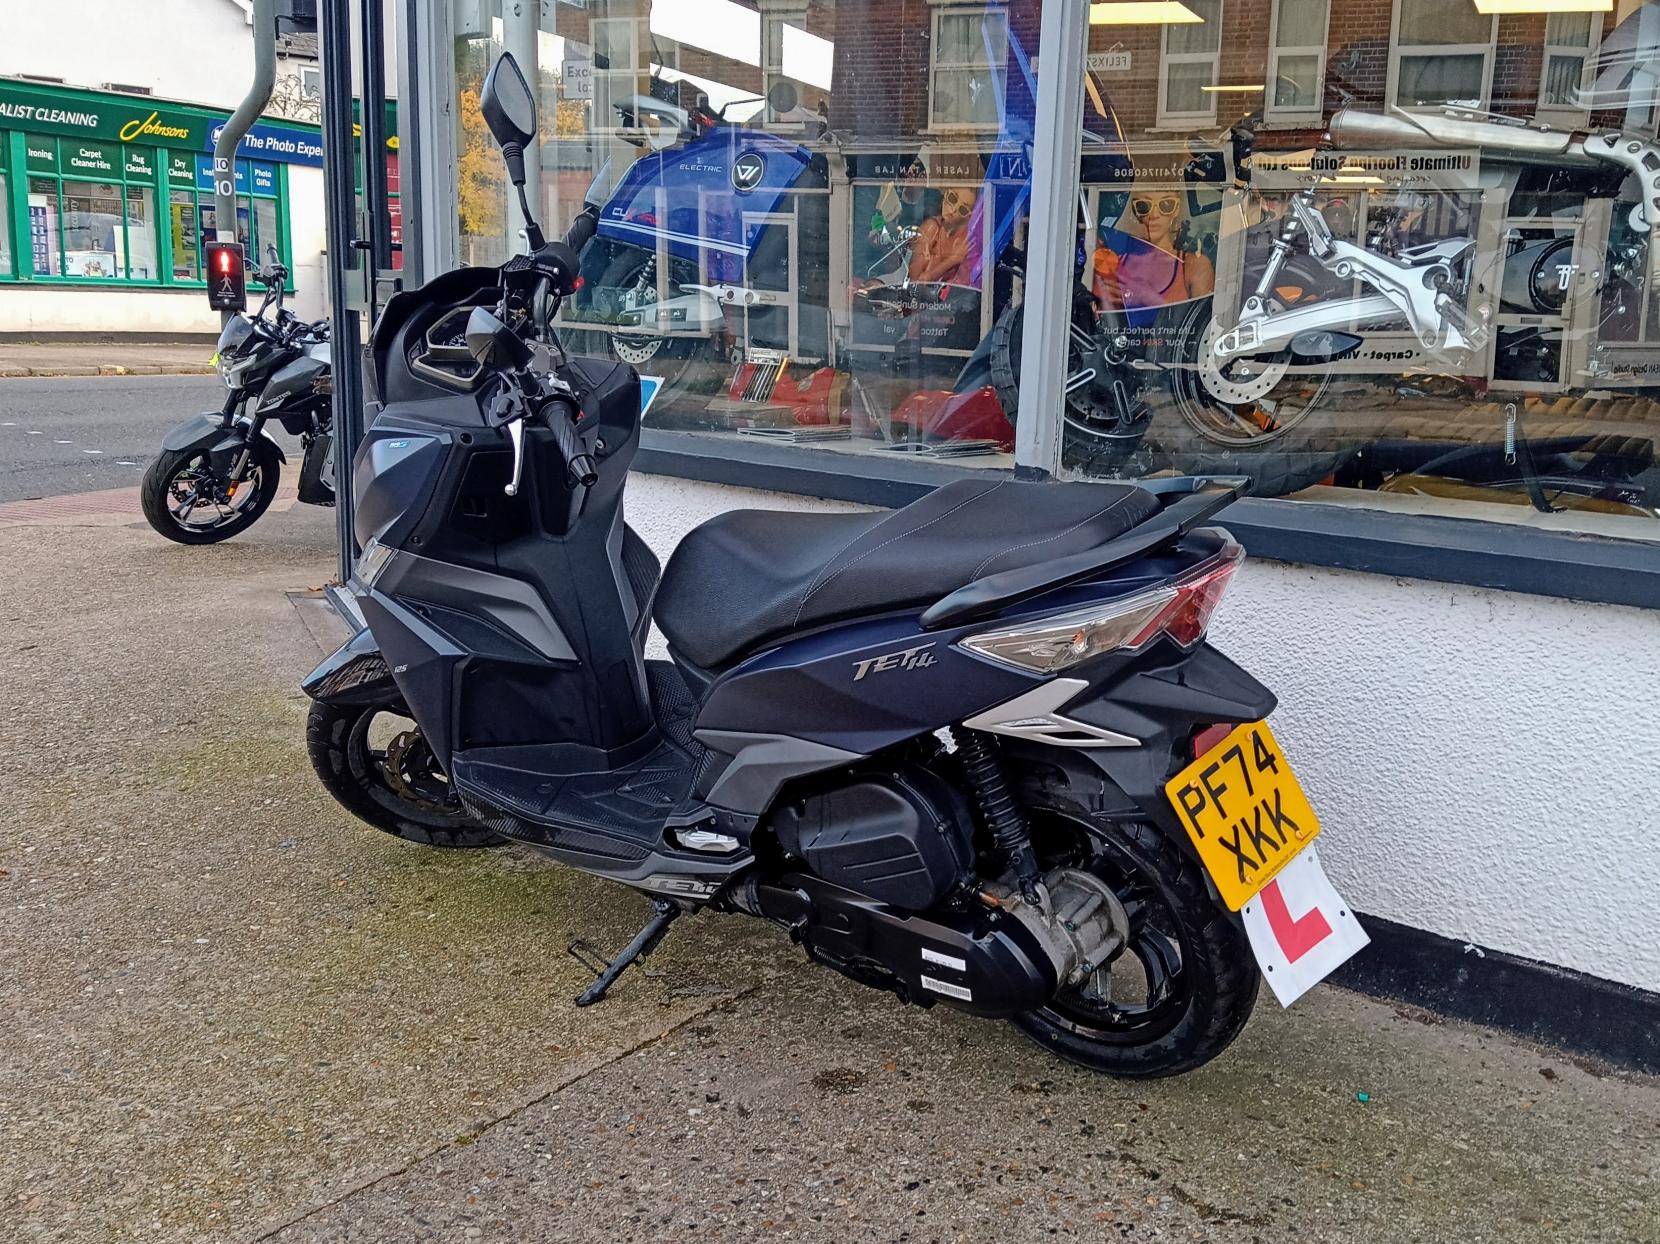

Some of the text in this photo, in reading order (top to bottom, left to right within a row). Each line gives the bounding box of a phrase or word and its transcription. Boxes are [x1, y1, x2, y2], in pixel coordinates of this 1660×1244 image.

[36, 107, 99, 127] CLEANING
[119, 111, 190, 141] Johnsons
[244, 134, 264, 149] The
[265, 137, 295, 153] Photo
[28, 148, 53, 160] Ironing
[79, 149, 102, 159] Carpet
[132, 154, 144, 165] Rug
[71, 158, 111, 170] Cleaner Hire
[125, 164, 153, 175] Cleaning
[174, 159, 186, 169] Dry
[216, 159, 229, 170] 10
[679, 164, 724, 173] ELECTRIC
[168, 168, 194, 180] Cleaning
[254, 168, 272, 178] Photo
[214, 180, 233, 197] 10
[256, 178, 271, 187] Gifts
[1176, 729, 1279, 839] PF74
[1217, 787, 1300, 884] XKK
[1259, 878, 1334, 964] L
